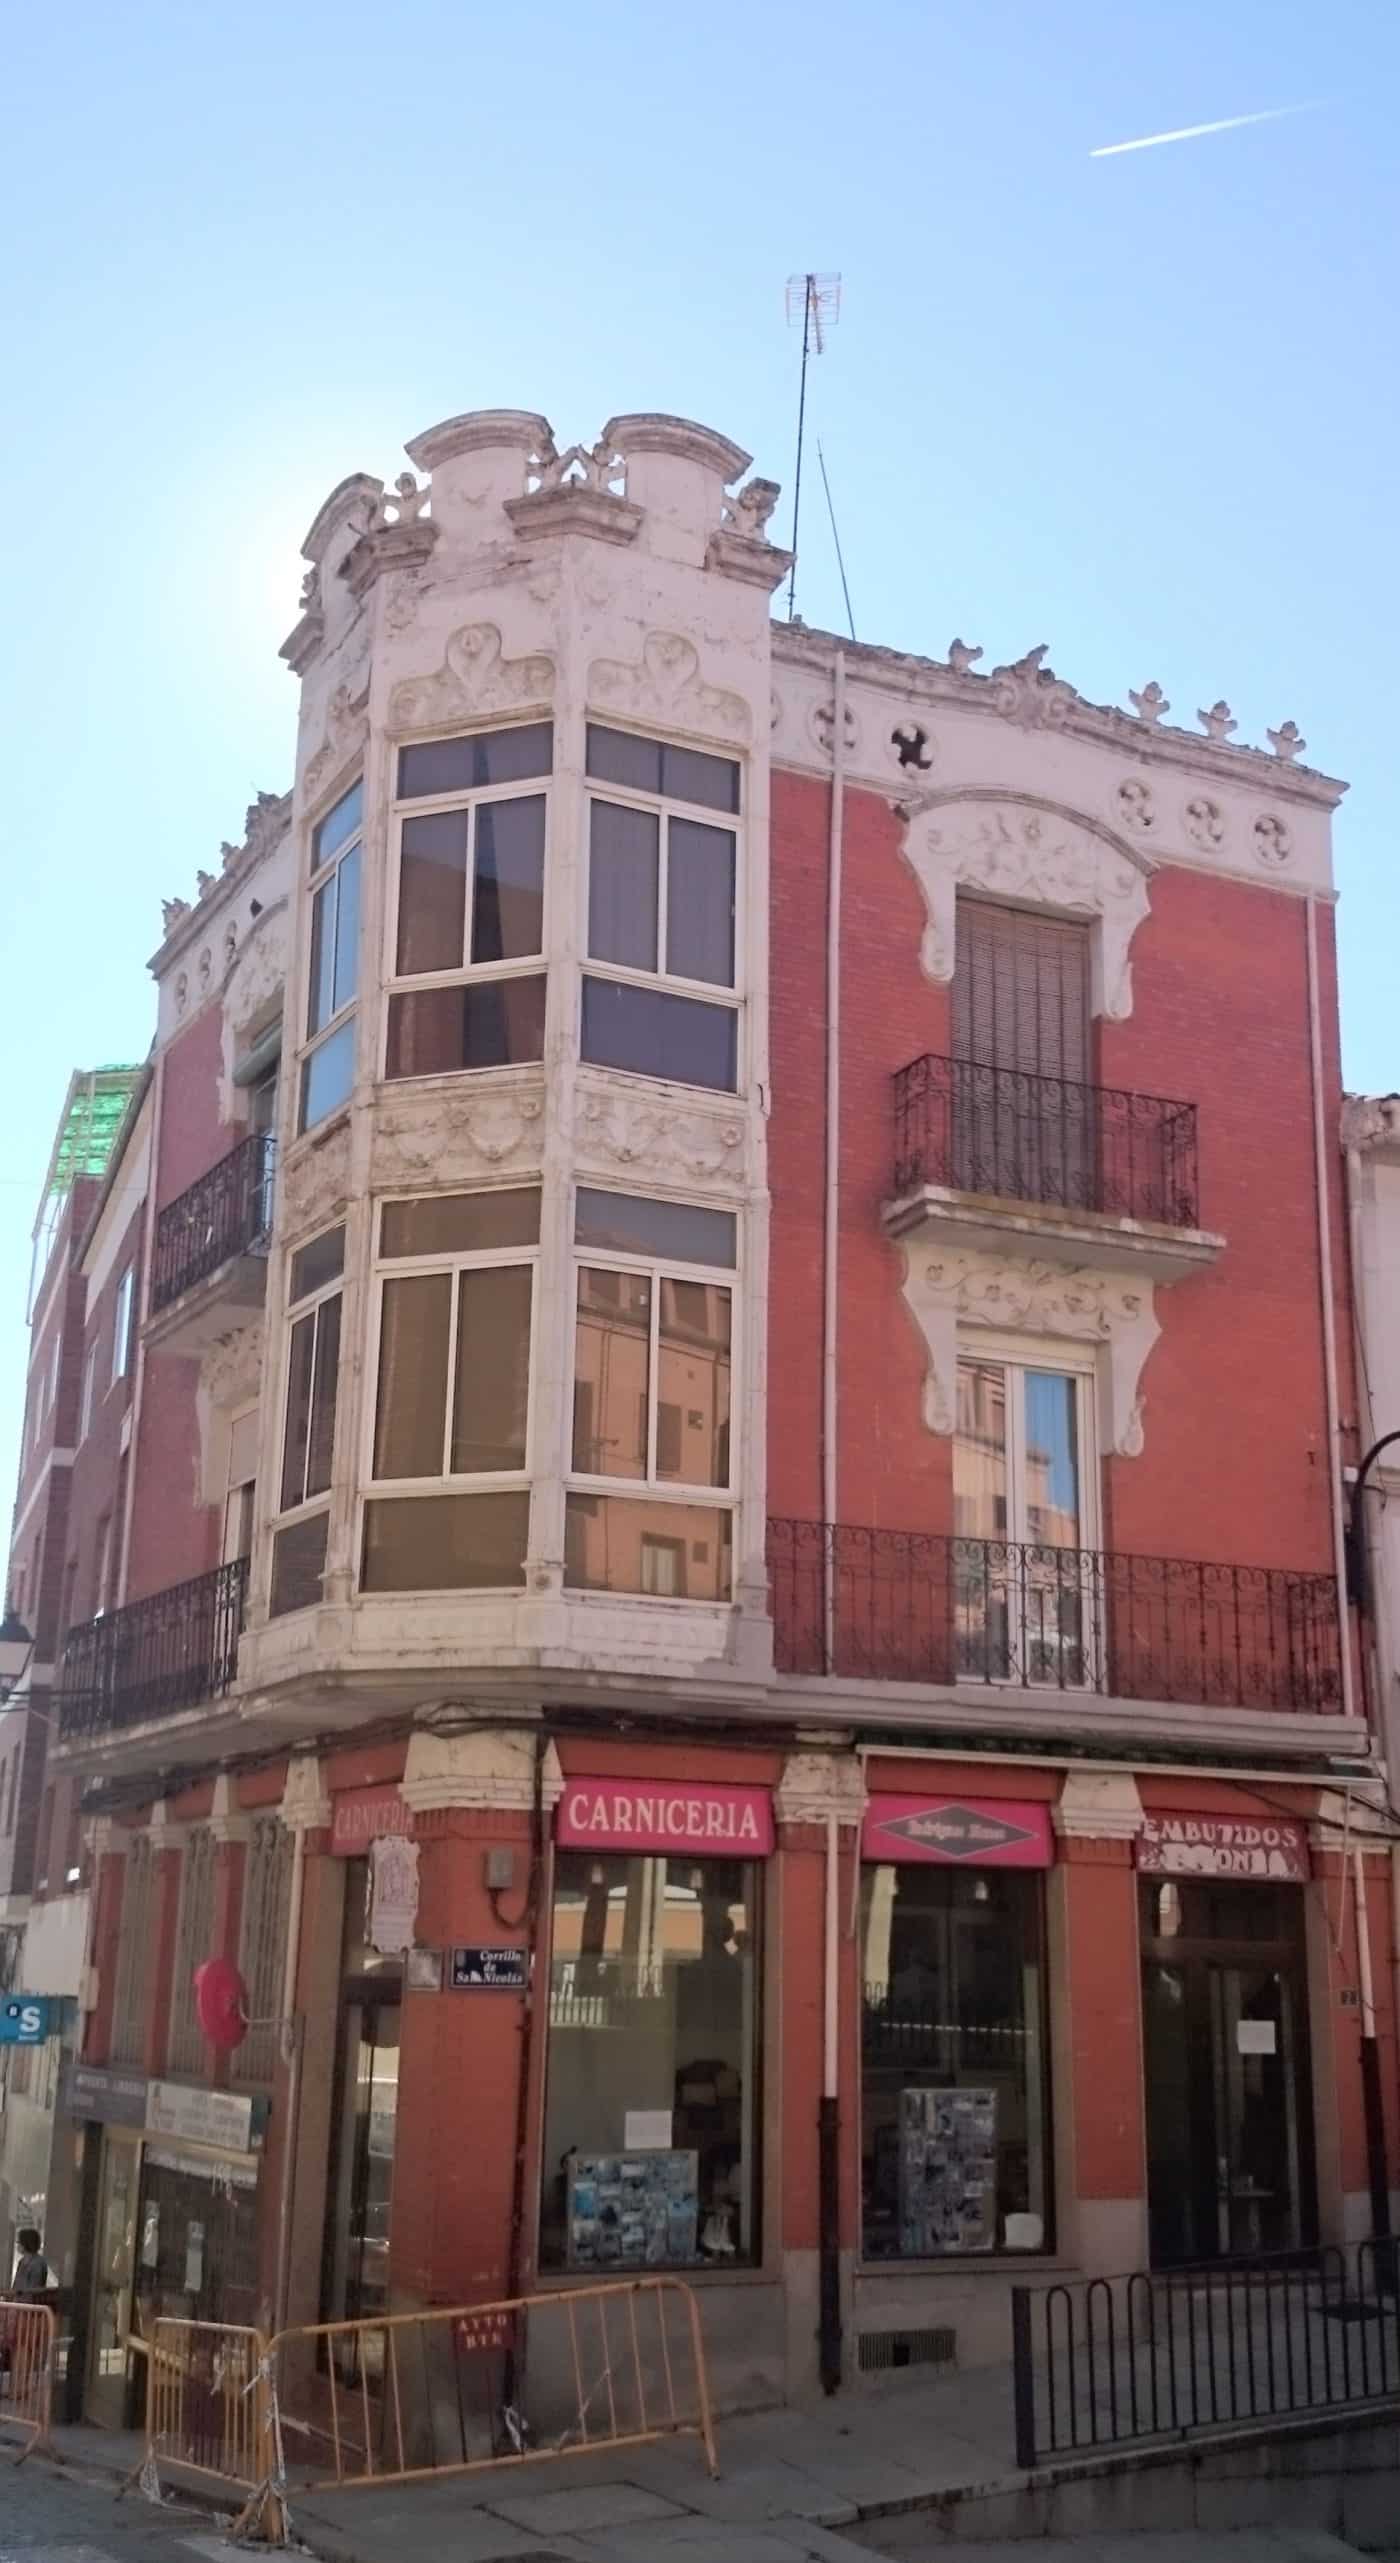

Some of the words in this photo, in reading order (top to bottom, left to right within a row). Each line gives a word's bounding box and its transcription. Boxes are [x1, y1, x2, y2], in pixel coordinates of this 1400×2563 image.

[569, 1794, 758, 1838] CARNICERIA
[1143, 1819, 1298, 1847] EMBUTIDOS
[480, 1950, 522, 1961] Corrillo
[483, 1961, 497, 1973] de
[456, 1971, 483, 1984] Sa
